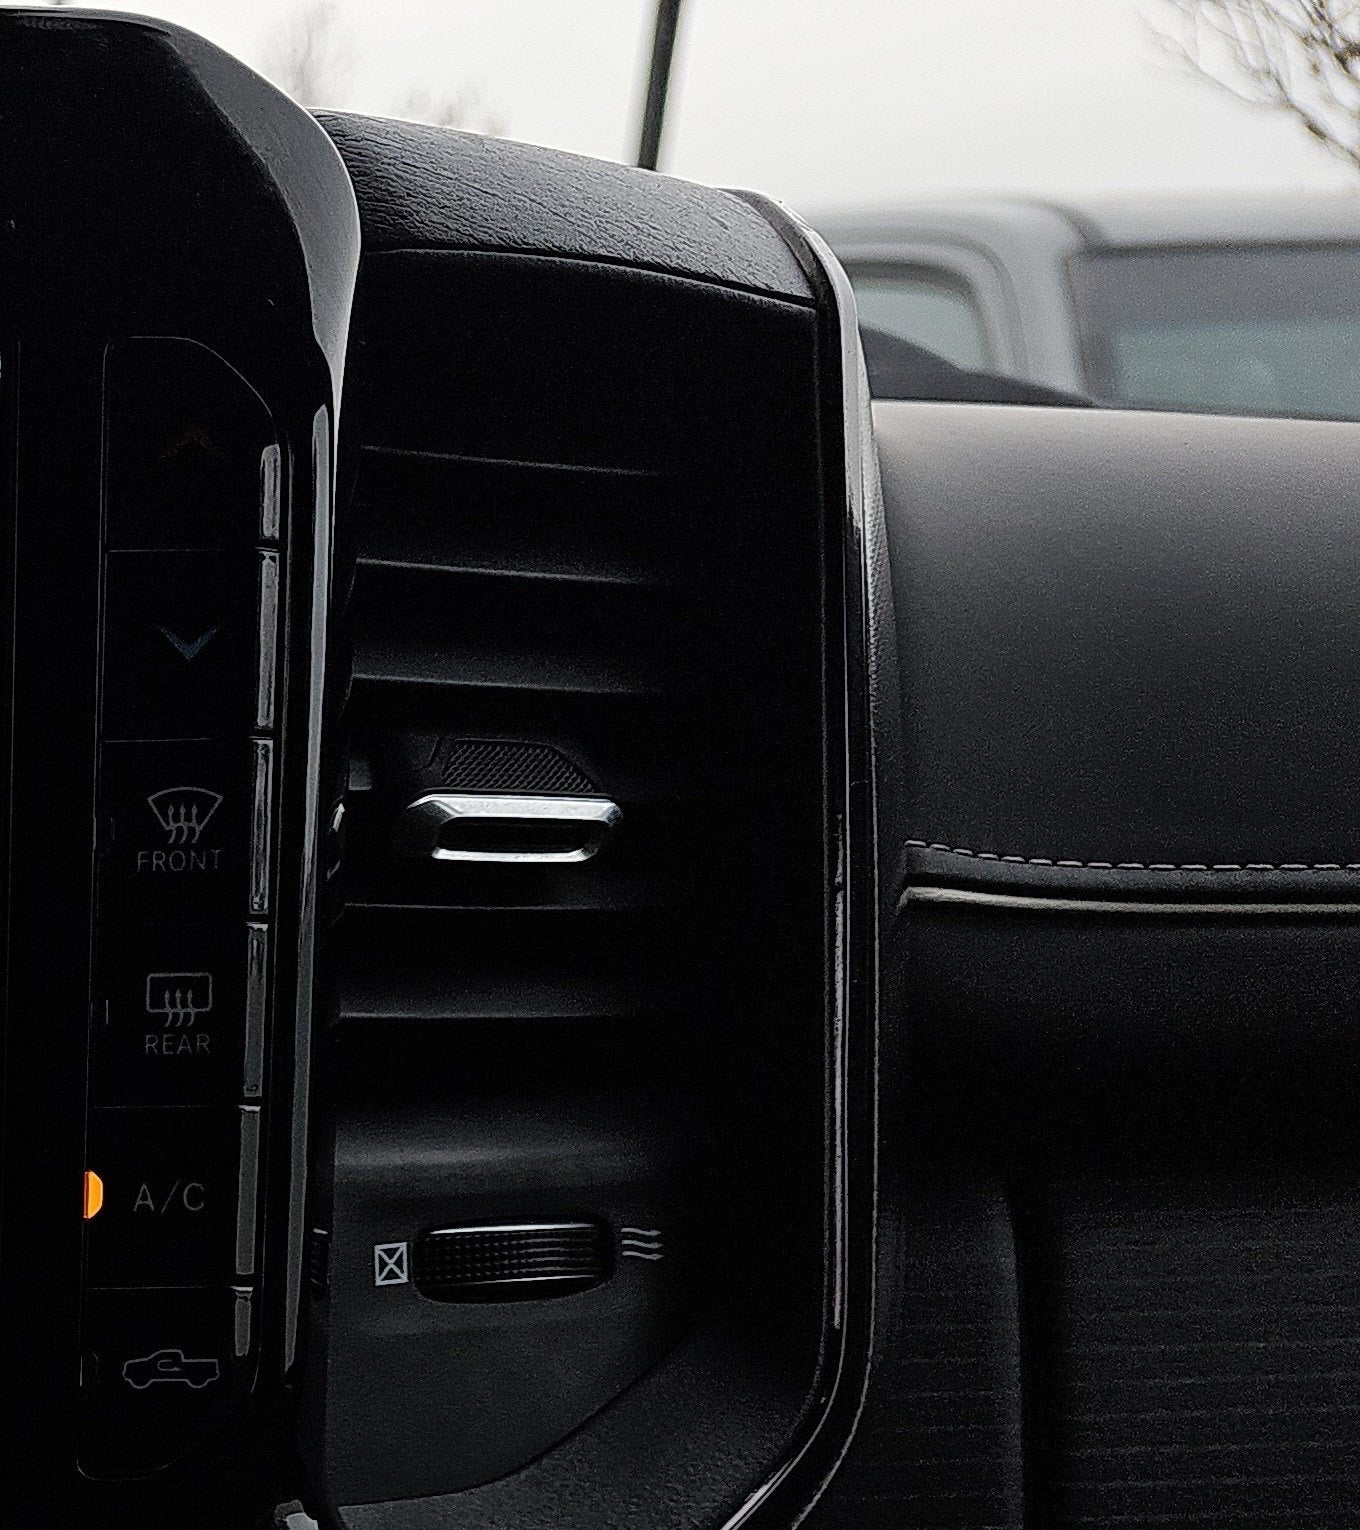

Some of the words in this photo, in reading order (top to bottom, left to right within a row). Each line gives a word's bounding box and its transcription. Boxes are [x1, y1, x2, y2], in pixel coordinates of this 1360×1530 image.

[136, 848, 223, 873] FRONT
[144, 1032, 212, 1056] REAR
[133, 1180, 206, 1216] A/C
